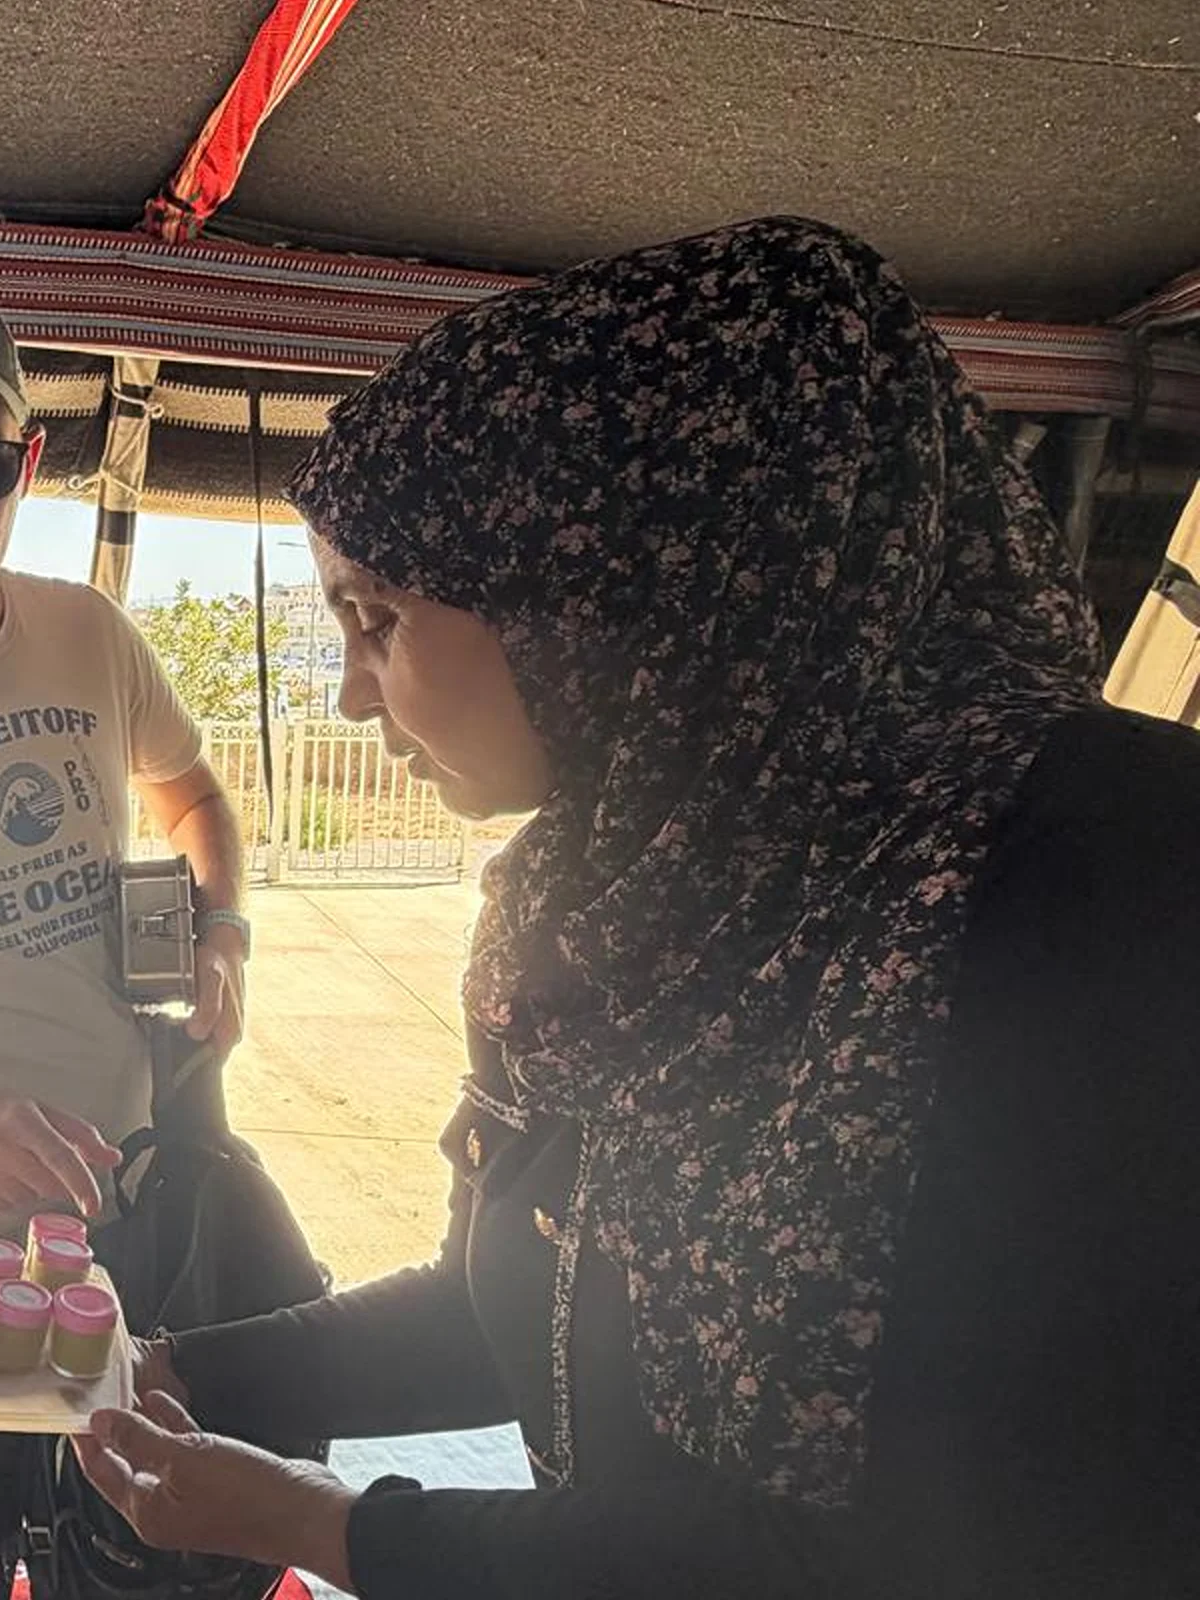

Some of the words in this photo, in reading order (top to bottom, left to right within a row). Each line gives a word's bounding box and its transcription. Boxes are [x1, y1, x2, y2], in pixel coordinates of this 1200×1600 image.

[63, 760, 90, 812] PRO
[21, 849, 64, 875] FREE
[67, 841, 88, 860] AS
[24, 857, 120, 914] OCEA
[22, 916, 60, 941] YOUR
[22, 921, 101, 960] CALIFORNIA
